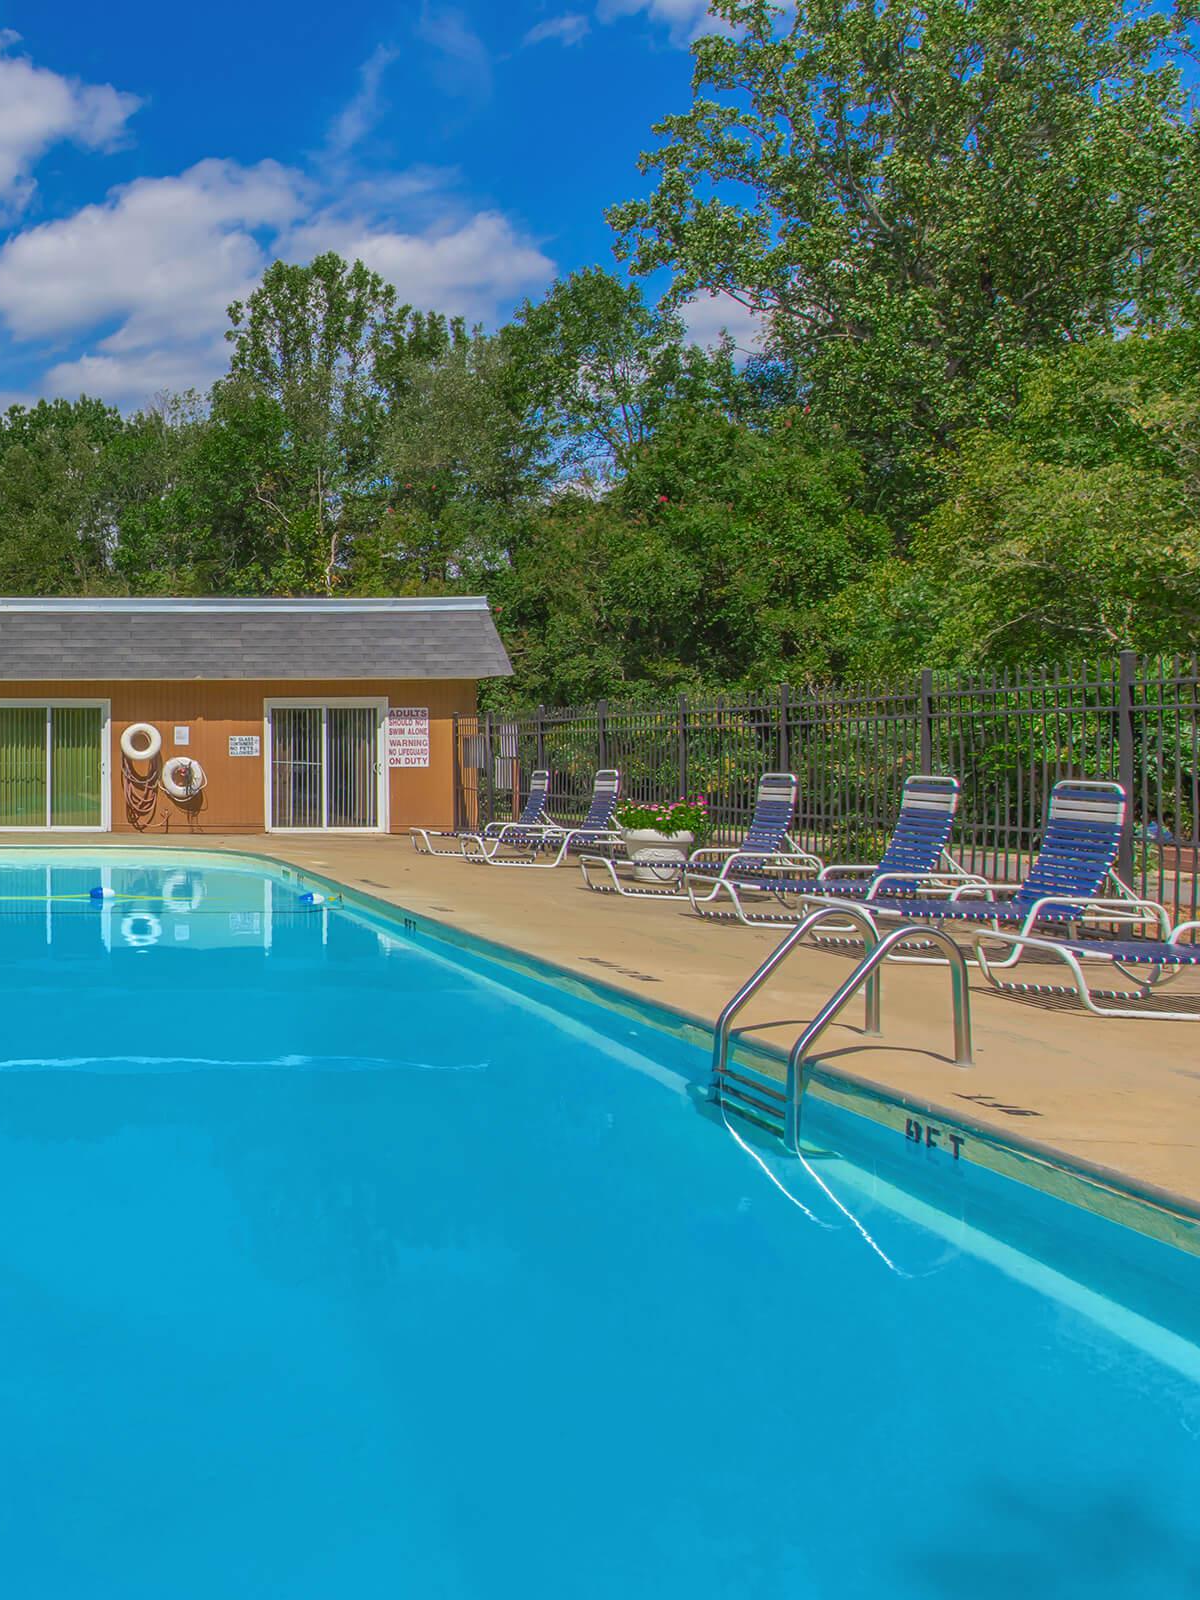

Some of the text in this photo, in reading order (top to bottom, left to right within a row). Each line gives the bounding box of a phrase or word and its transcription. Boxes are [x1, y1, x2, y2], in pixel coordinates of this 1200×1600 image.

[389, 709, 428, 718] ADULTS
[389, 728, 428, 736] SWIM ALONE
[389, 739, 428, 747] WARNING
[389, 748, 428, 756] NO LIFEGUARD
[389, 757, 428, 766] ON DUTY
